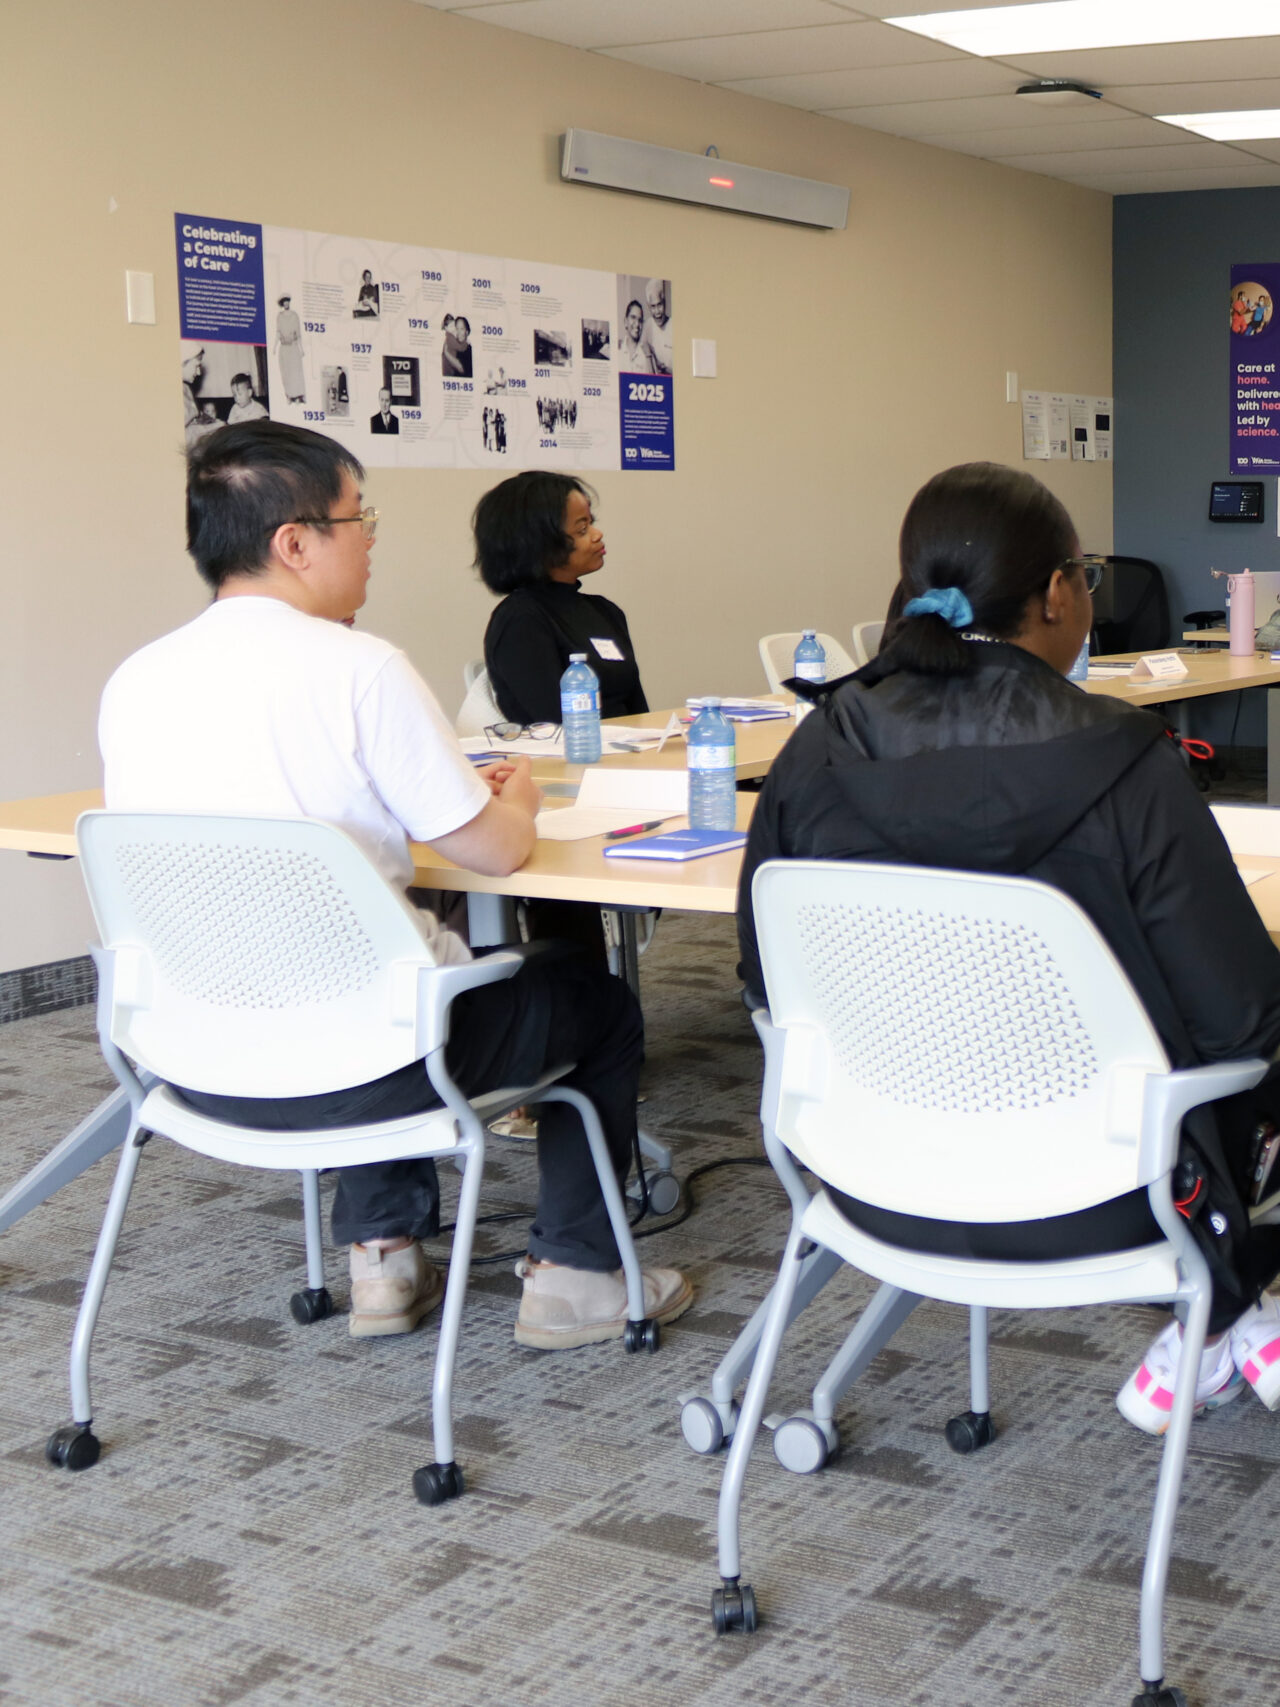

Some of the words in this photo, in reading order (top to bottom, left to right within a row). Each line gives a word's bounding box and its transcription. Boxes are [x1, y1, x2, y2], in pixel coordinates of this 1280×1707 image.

[182, 224, 257, 249] Celebrating
[183, 242, 192, 253] a
[194, 241, 246, 262] Century
[184, 256, 199, 268] of
[200, 257, 231, 273] Care
[421, 270, 442, 282] 1980
[381, 281, 401, 293] 1951
[472, 278, 492, 289] 2001
[520, 283, 541, 294] 2009
[304, 321, 326, 334] 1925
[408, 318, 429, 330] 1976
[482, 325, 503, 336] 2000
[351, 343, 372, 354] 1937
[534, 368, 551, 378] 2011
[1237, 364, 1262, 373] Care
[1264, 364, 1275, 373] at
[508, 378, 527, 388] 1998
[1237, 375, 1270, 385] home.
[442, 380, 474, 392] 1981-85
[583, 387, 602, 397] 2020
[628, 382, 665, 402] 2025
[1237, 400, 1260, 411] with
[303, 410, 326, 422] 1935
[401, 410, 422, 420] 1969
[1237, 416, 1255, 425] Led
[1256, 416, 1270, 428] by
[1237, 428, 1279, 437] science.
[539, 438, 558, 448] 2014
